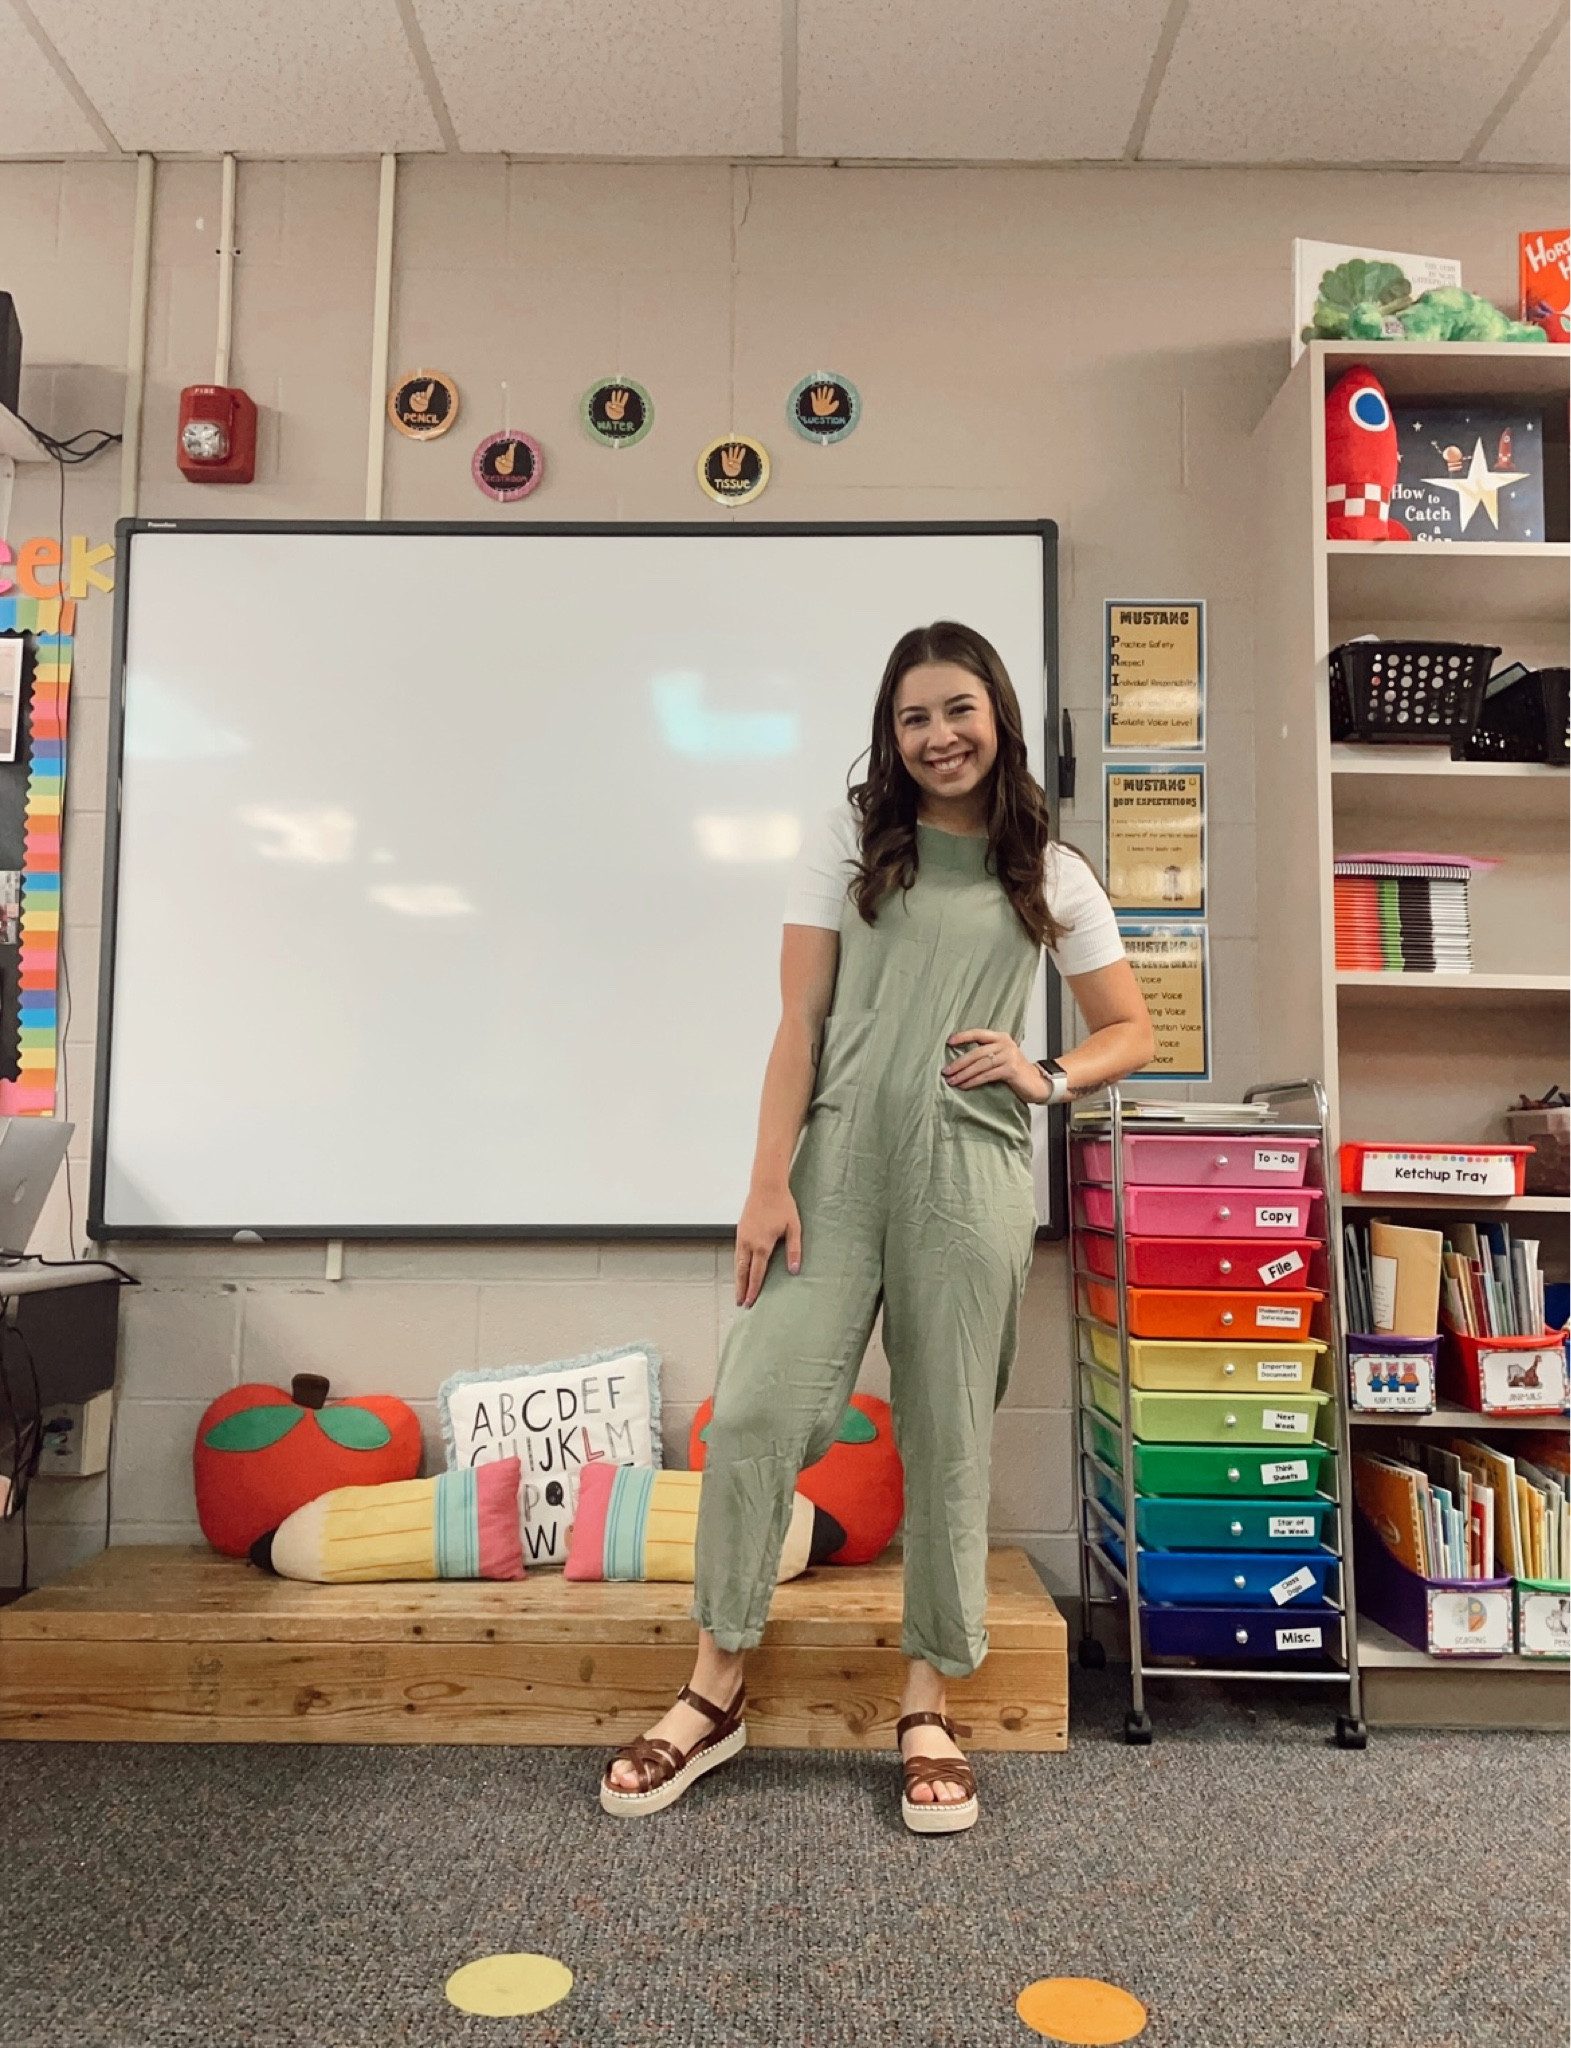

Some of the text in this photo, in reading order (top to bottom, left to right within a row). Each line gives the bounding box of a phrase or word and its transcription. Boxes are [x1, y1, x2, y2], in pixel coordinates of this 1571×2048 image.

[403, 412, 440, 424] PENCIL
[596, 421, 635, 431] WATER
[714, 479, 751, 489] TISSUE
[1391, 483, 1440, 504] How to
[1404, 506, 1452, 522] Catch
[1433, 525, 1441, 534] a
[1120, 611, 1189, 624] MUSTANG
[1149, 640, 1174, 649] Safety
[1171, 718, 1193, 726] Level
[1123, 779, 1186, 791] MUSTANG
[1113, 798, 1197, 807] BODY EXPECTATIONS
[1125, 941, 1188, 953] MUSTANG
[1141, 976, 1161, 984] Voice
[1162, 992, 1182, 1000] Voice
[1165, 1008, 1186, 1016] Voice
[1180, 1023, 1201, 1032] Voice
[1159, 1040, 1180, 1048] Voice
[1258, 1153, 1270, 1162] To
[1281, 1154, 1295, 1163] Do
[1395, 1167, 1488, 1184] Ketchup Tray
[1260, 1210, 1292, 1223] Copy
[1268, 1261, 1293, 1279] File
[1262, 1363, 1297, 1371] Important
[1276, 1413, 1295, 1421] Next
[1275, 1464, 1293, 1472] Think
[1272, 1473, 1299, 1481] Sheets
[524, 1521, 557, 1559] W
[1282, 1632, 1315, 1644] Misc.
